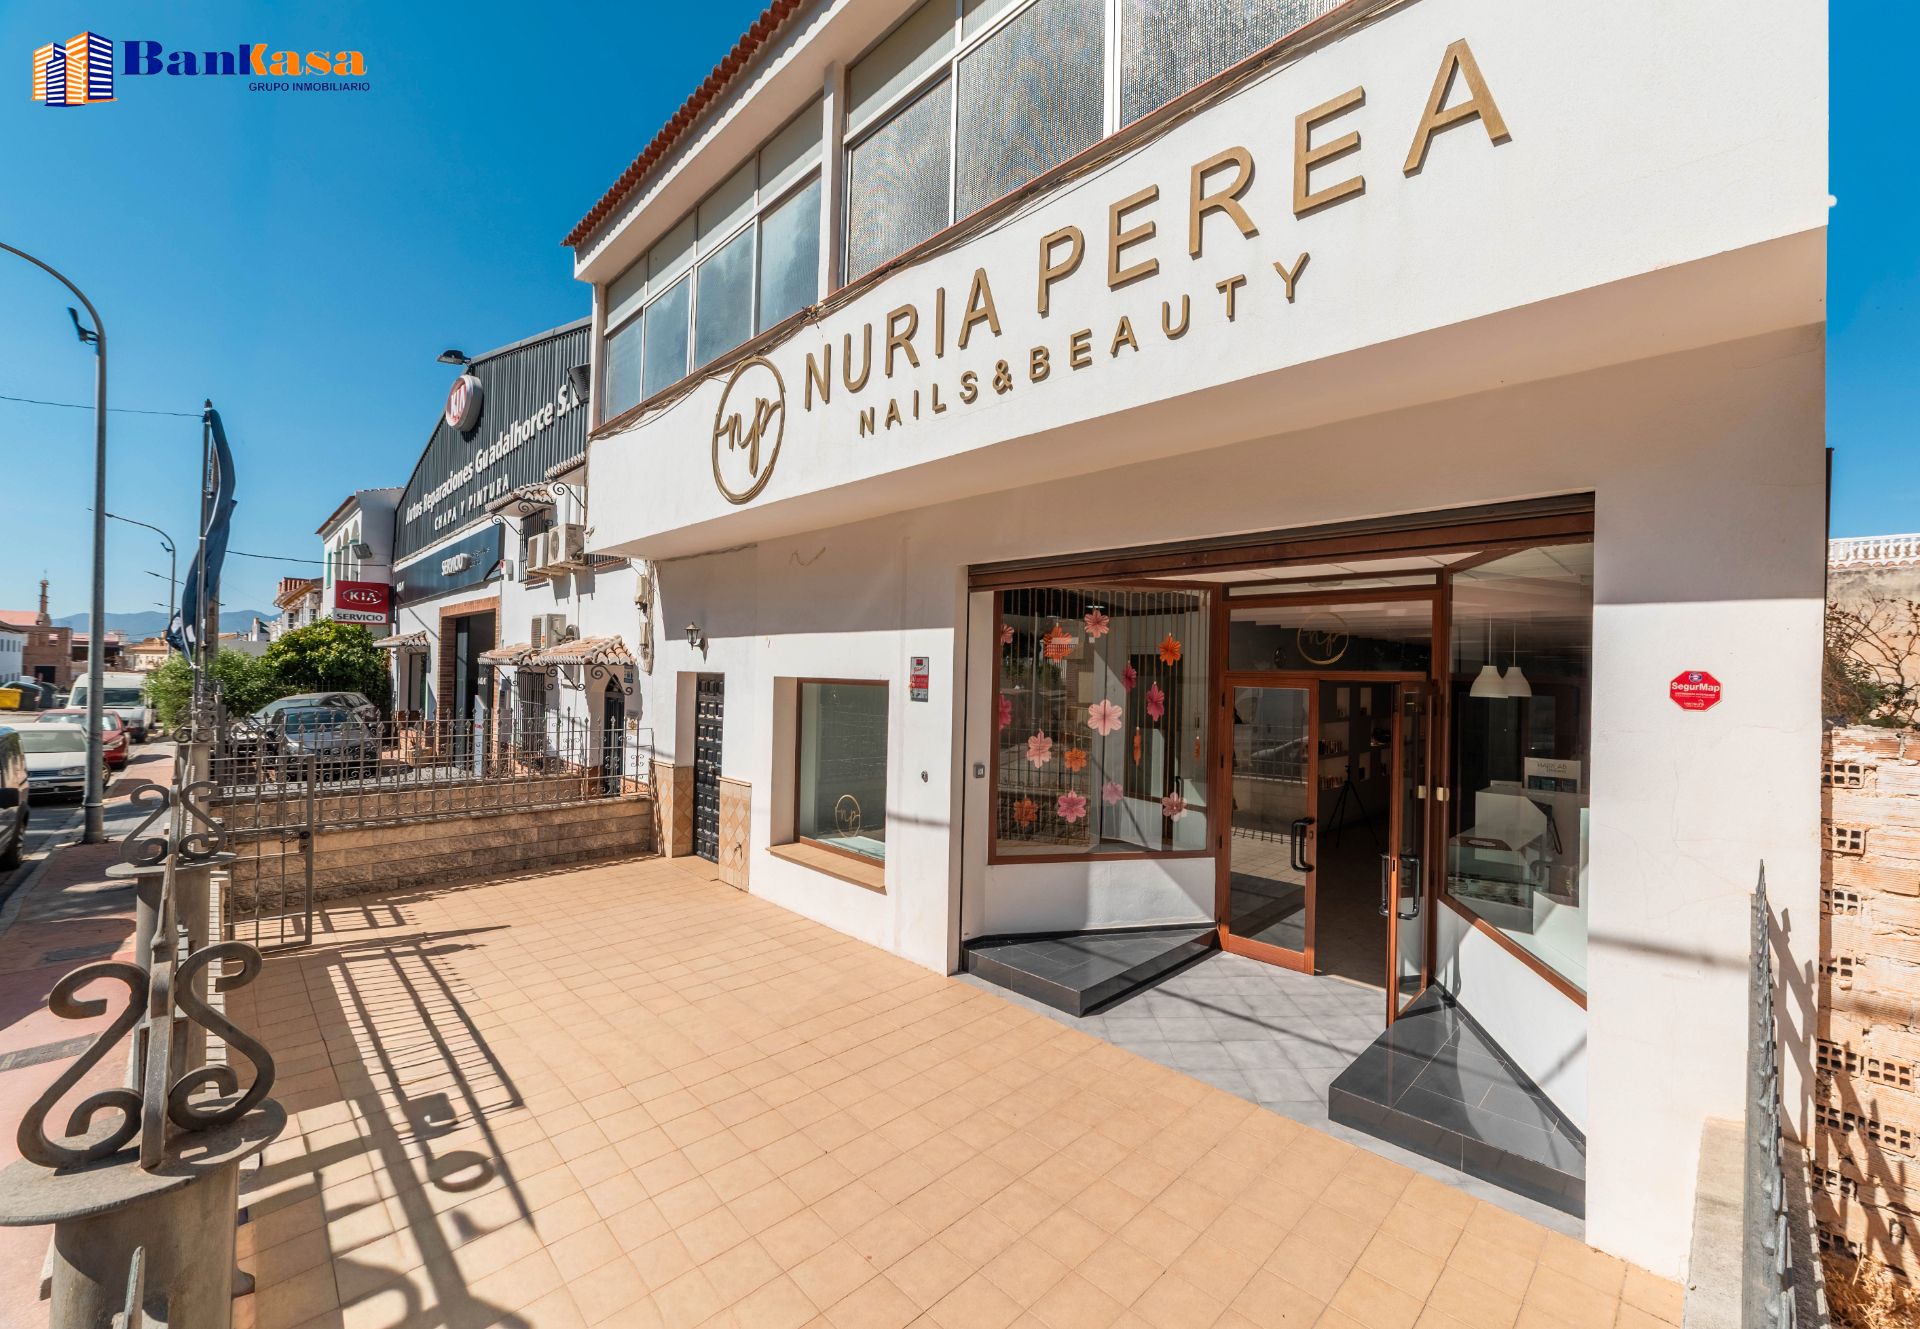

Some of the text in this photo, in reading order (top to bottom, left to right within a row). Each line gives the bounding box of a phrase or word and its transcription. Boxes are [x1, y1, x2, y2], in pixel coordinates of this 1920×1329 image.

[799, 38, 1512, 413] NURIA PEREA
[423, 462, 473, 514] Reparaciones
[475, 402, 554, 473] Guadalhorce
[434, 474, 509, 531] CHAPA Y PINTURA
[349, 591, 377, 602] KIA
[336, 612, 384, 622] SERVICIO
[1671, 681, 1720, 693] SegurMap
